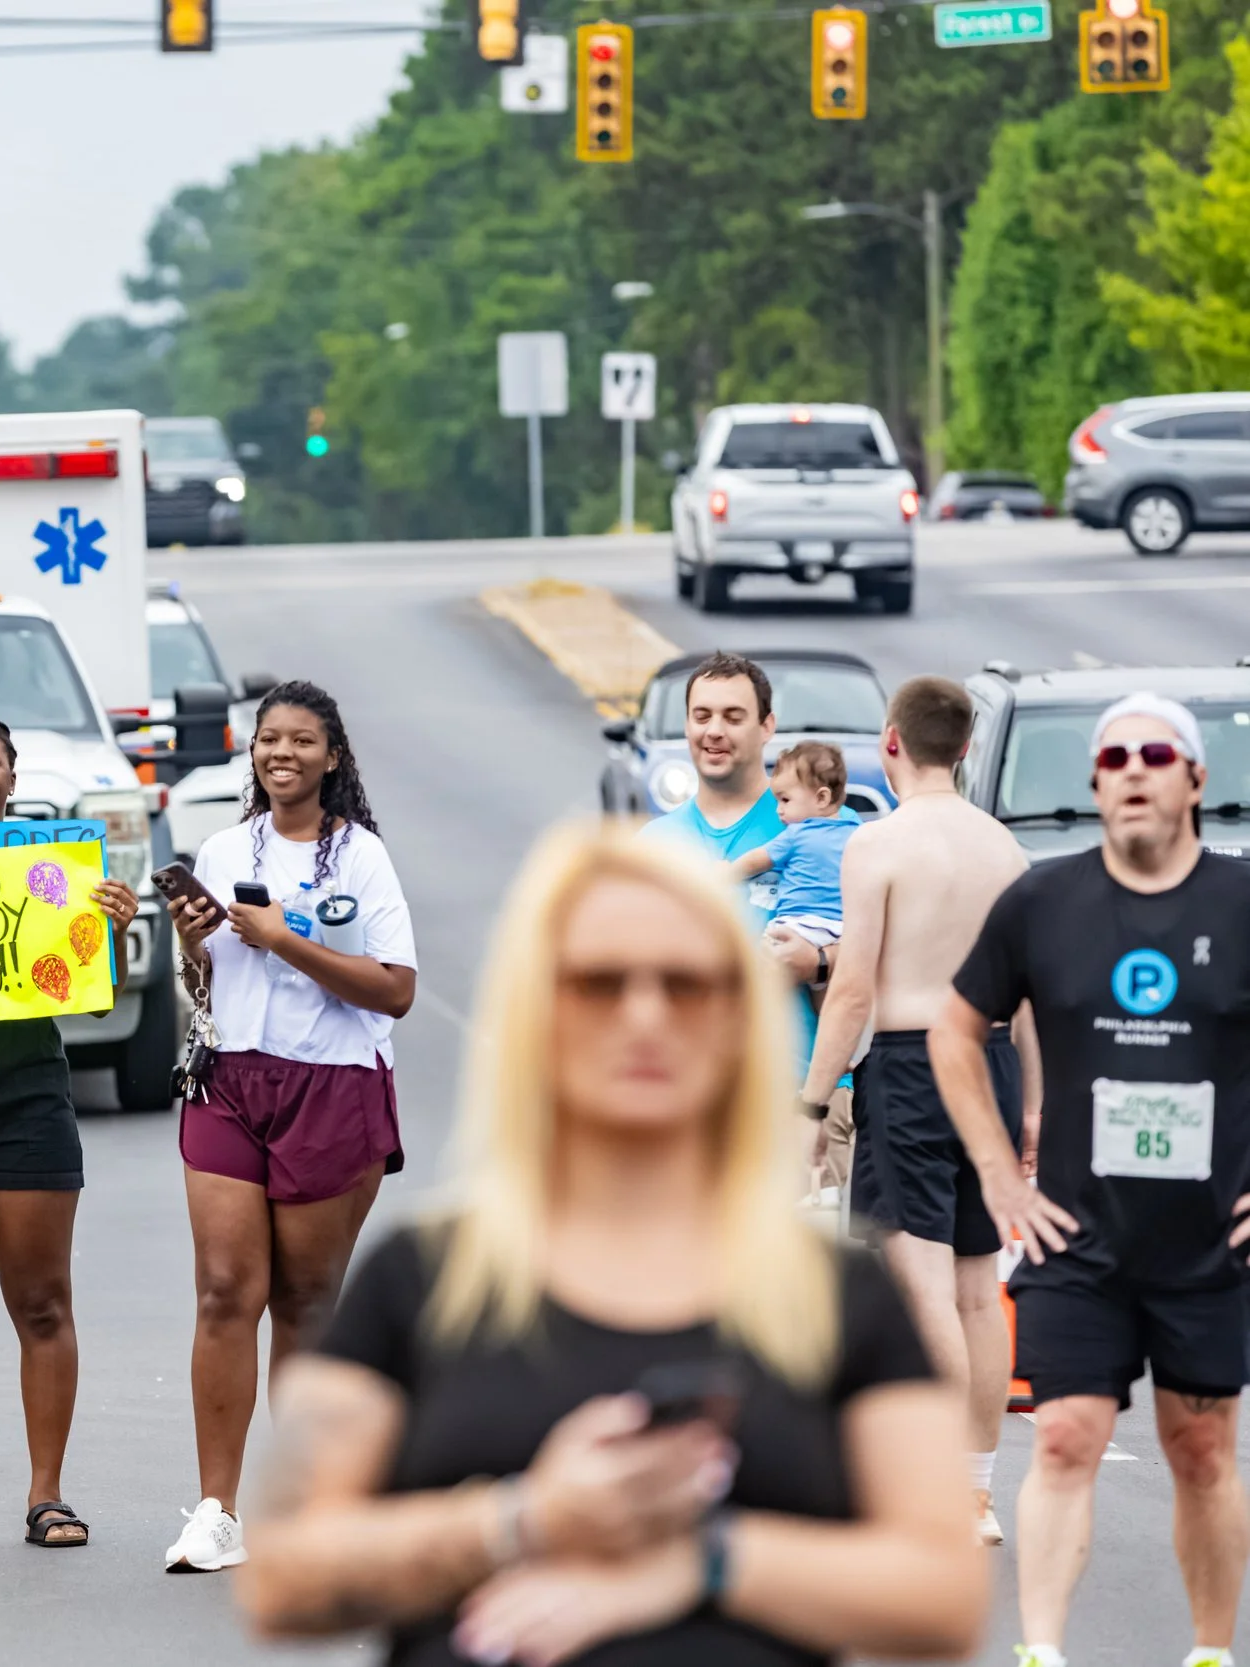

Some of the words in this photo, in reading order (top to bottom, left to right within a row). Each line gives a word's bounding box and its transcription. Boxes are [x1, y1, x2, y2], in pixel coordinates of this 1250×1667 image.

[1094, 1017, 1191, 1034] PHILADELPHIA
[1114, 1031, 1170, 1046] RUNNER
[1136, 1130, 1171, 1158] 85
